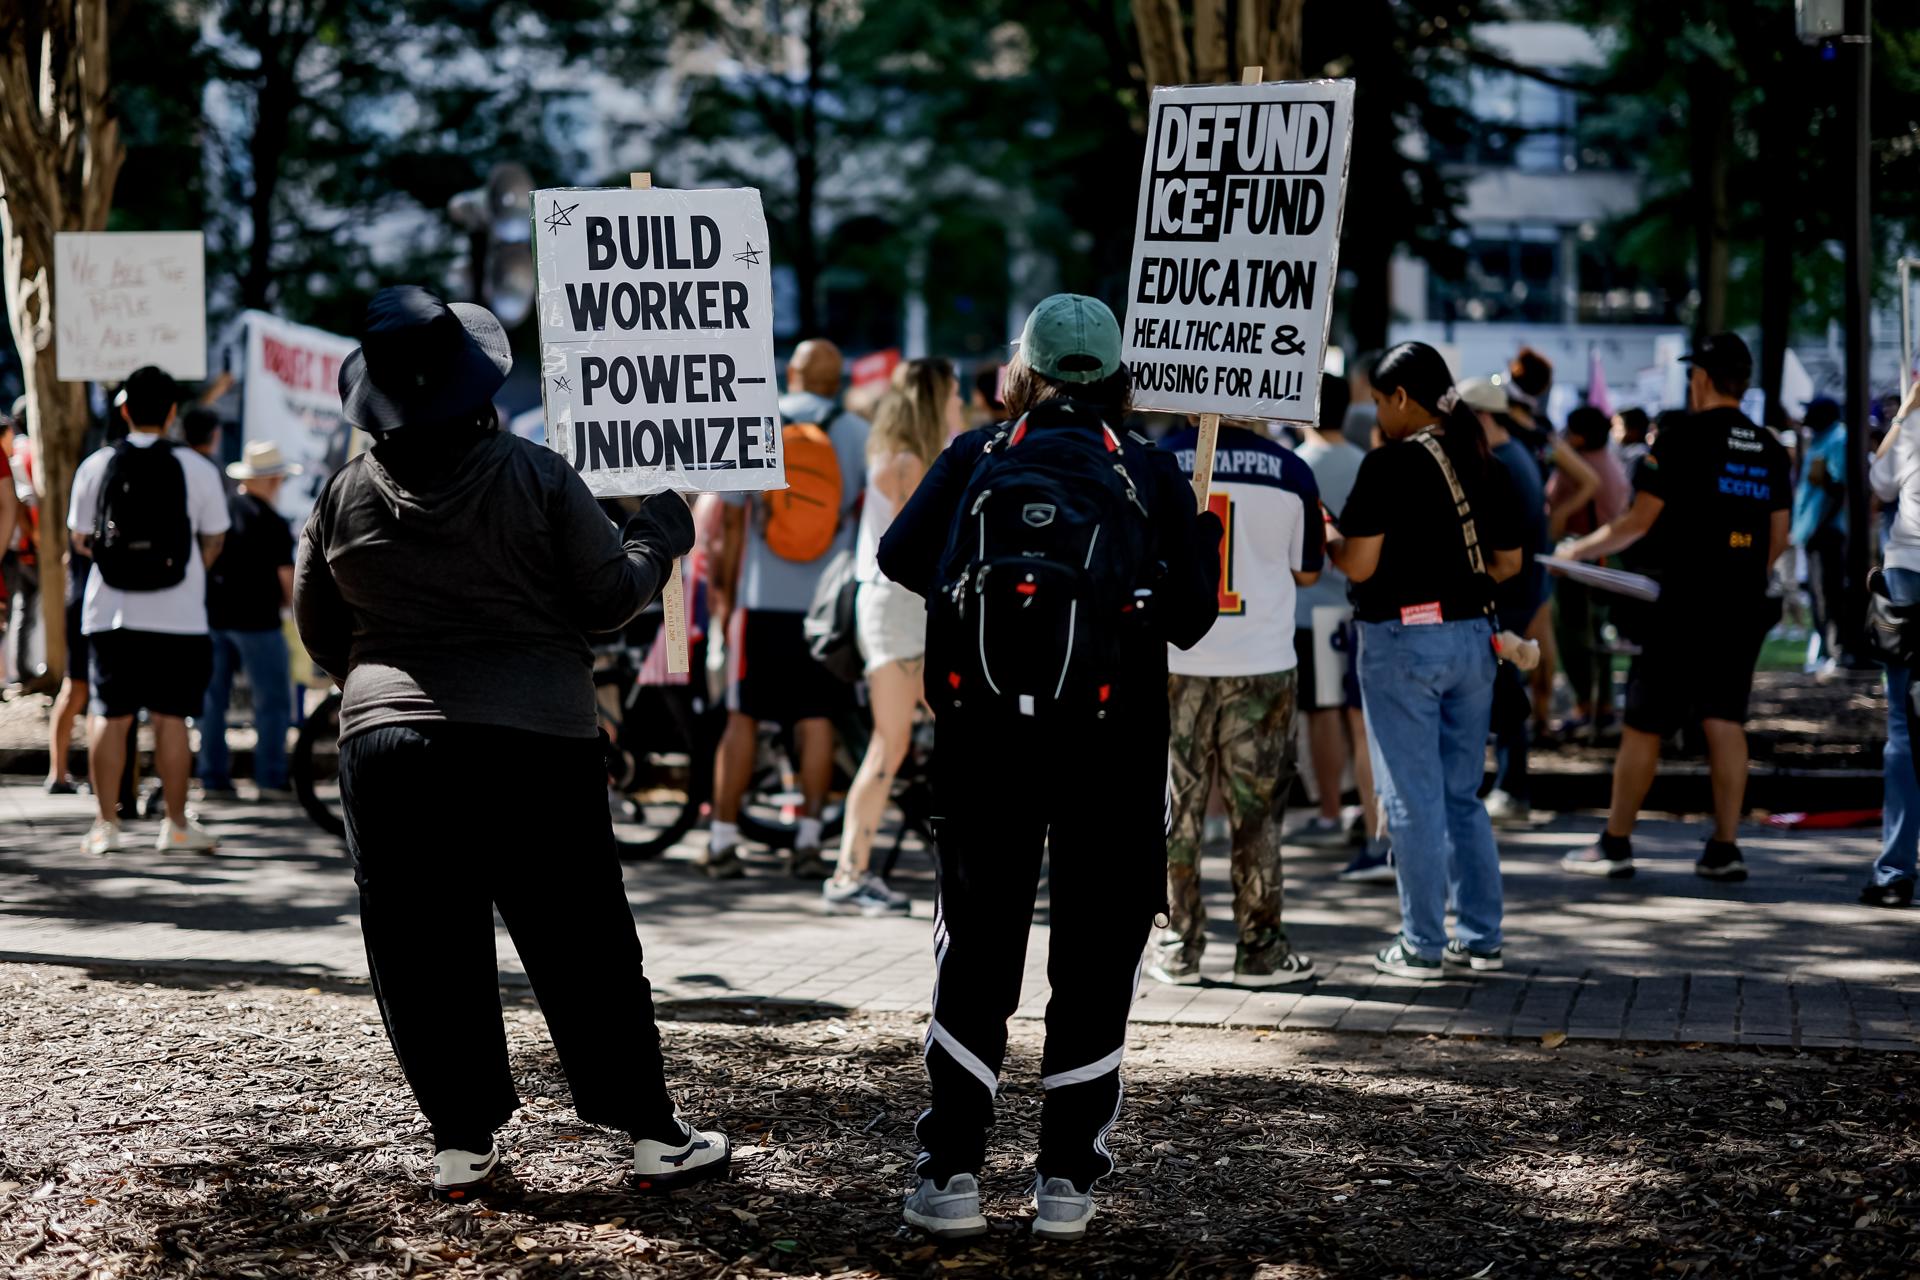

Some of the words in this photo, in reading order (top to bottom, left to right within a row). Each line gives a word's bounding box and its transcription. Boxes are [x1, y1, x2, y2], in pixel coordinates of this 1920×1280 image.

[1156, 104, 1330, 172] DEFUND
[1150, 178, 1217, 235] ICE:
[1223, 178, 1325, 236] FUND
[585, 215, 721, 270] BUILD
[565, 281, 750, 331] WORKER
[1136, 257, 1317, 310] EDUCATION
[1132, 317, 1266, 354] HEALTHCARE
[1271, 324, 1306, 356] &
[1129, 361, 1208, 394] HOUSING
[1214, 366, 1251, 397] FOR
[1258, 370, 1303, 401] ALL!
